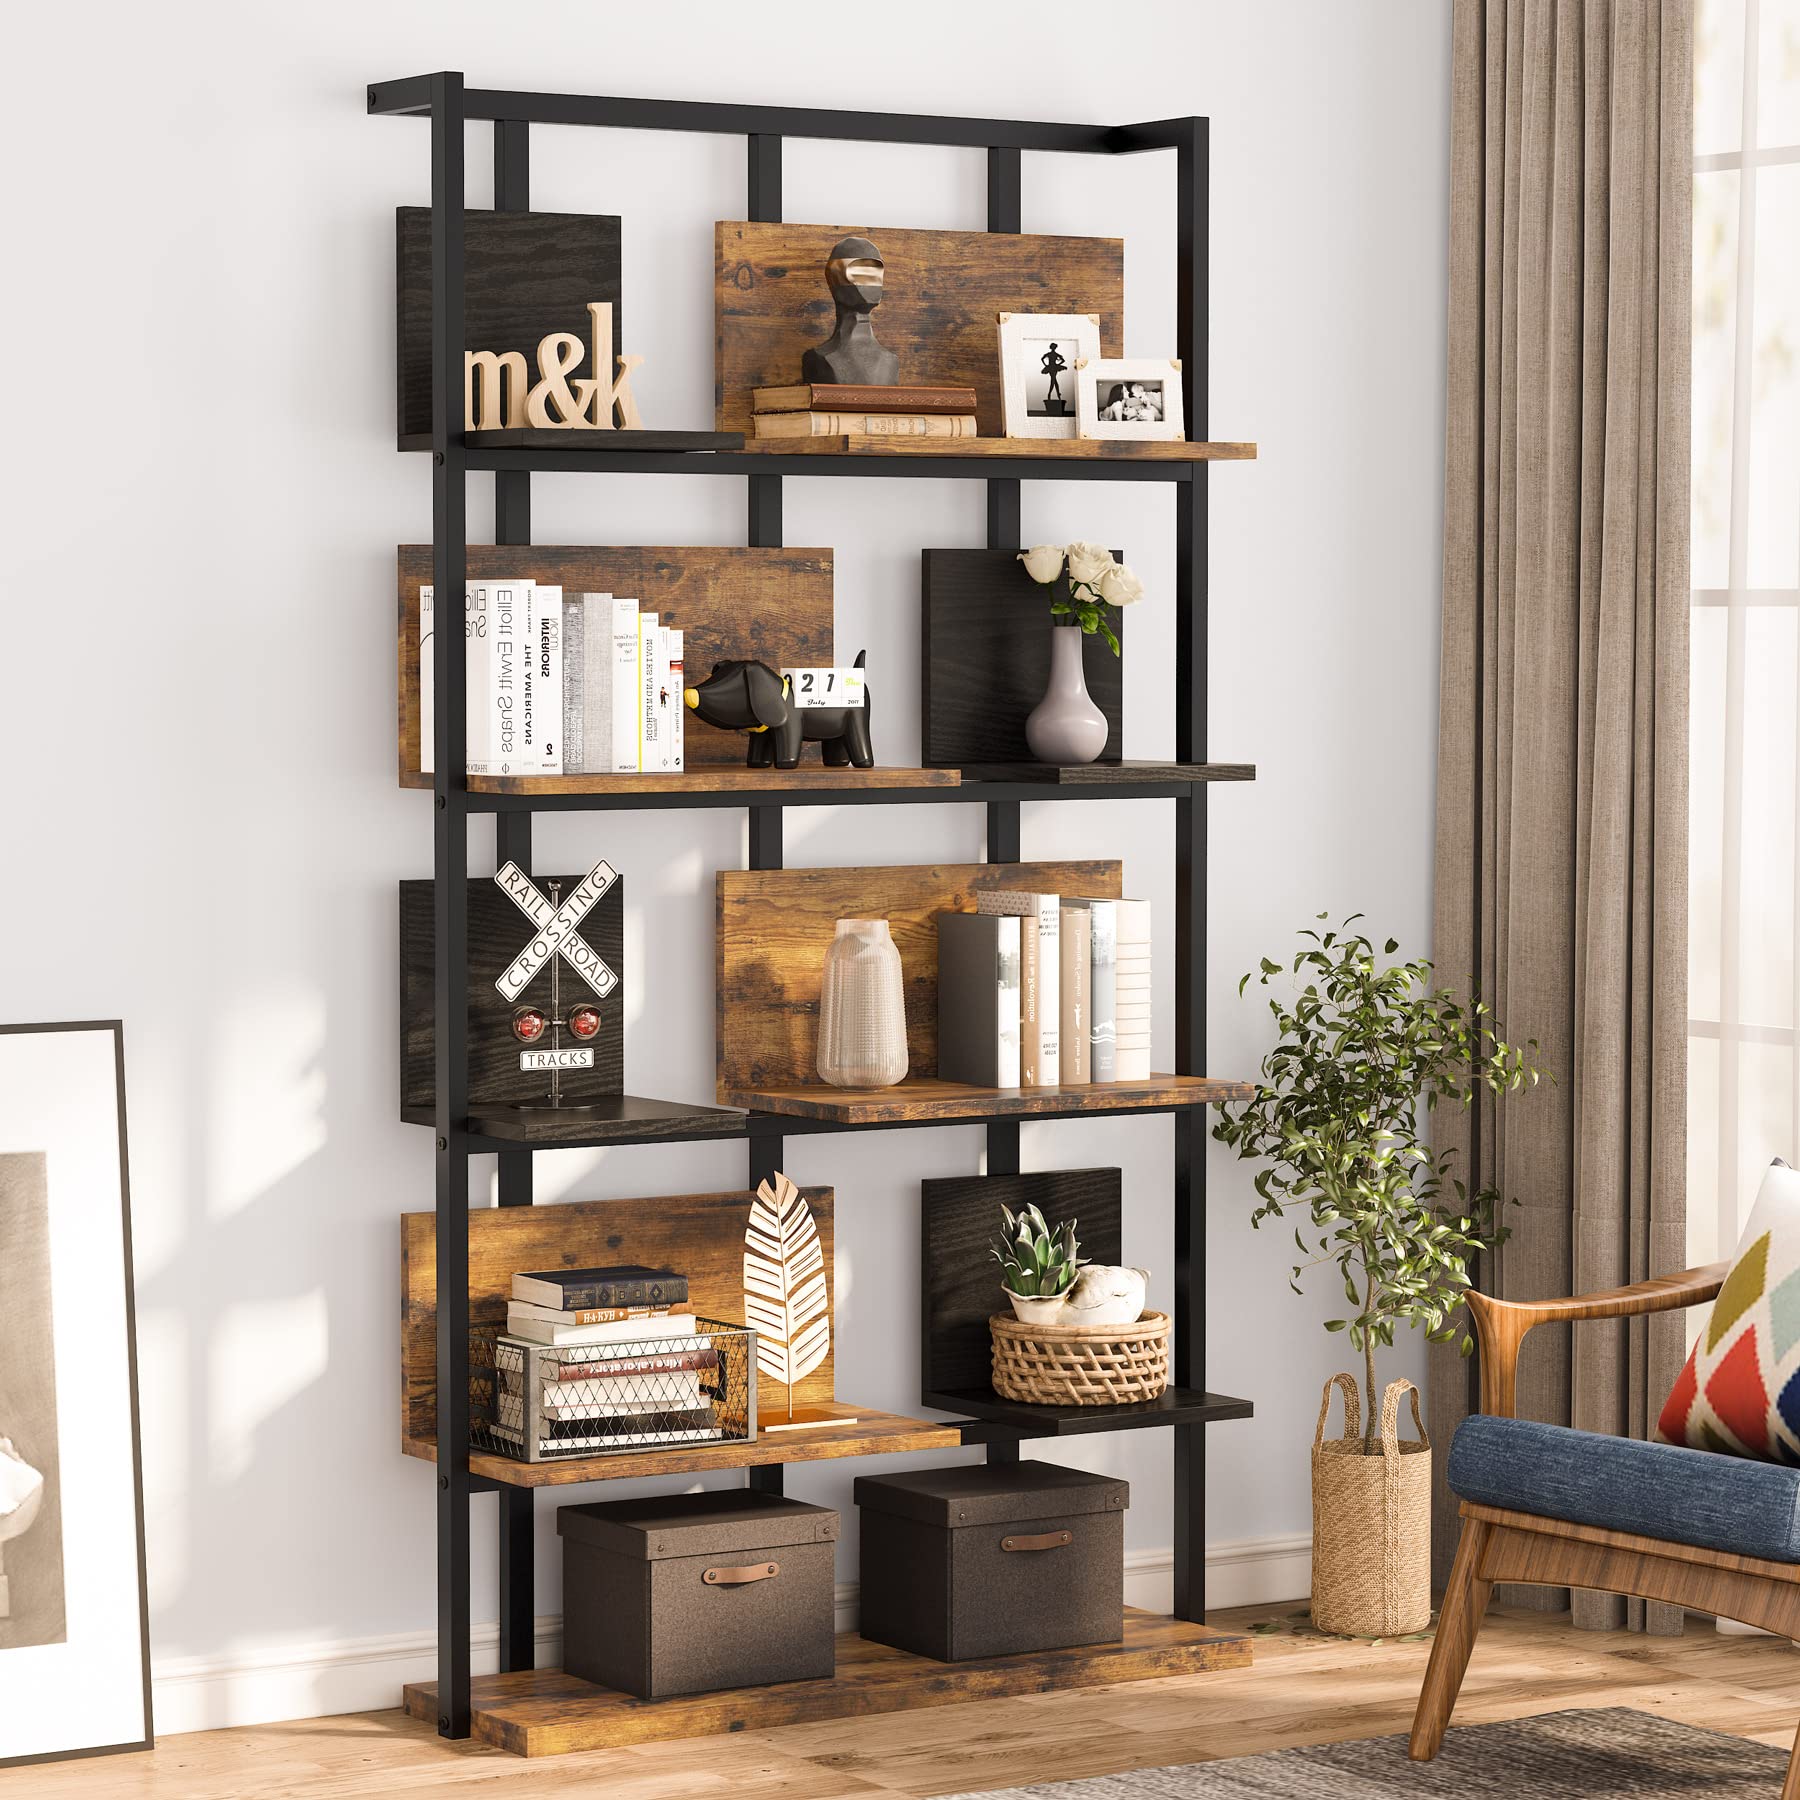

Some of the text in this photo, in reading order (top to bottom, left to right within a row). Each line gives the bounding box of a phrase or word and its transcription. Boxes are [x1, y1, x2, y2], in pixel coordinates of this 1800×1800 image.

[504, 871, 545, 920] RAIL
[507, 871, 607, 987] CROSSING
[563, 936, 610, 987] ROAD
[527, 1051, 587, 1067] TRACKS
